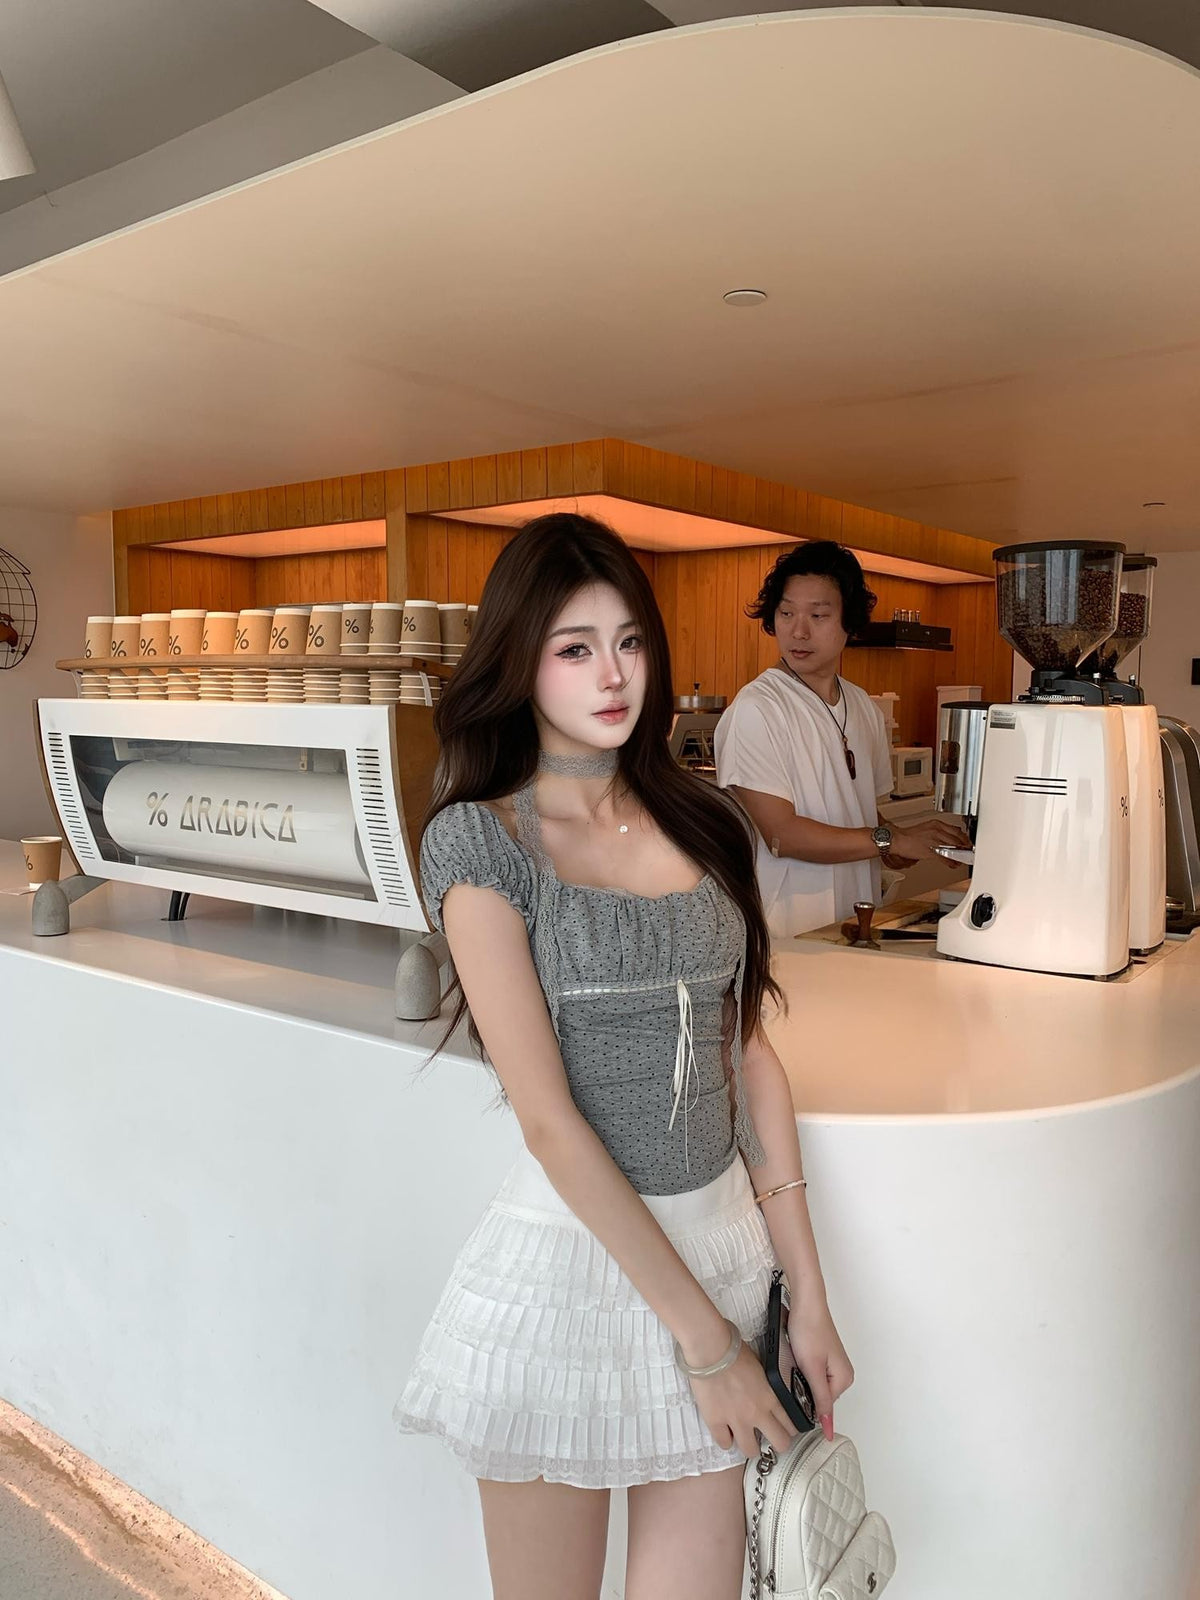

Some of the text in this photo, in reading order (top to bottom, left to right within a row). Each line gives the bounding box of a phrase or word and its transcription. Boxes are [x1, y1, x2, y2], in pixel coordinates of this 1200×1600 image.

[271, 626, 289, 650] %
[308, 624, 325, 648] %
[345, 618, 360, 634] %
[146, 791, 297, 843] % ARABICA
